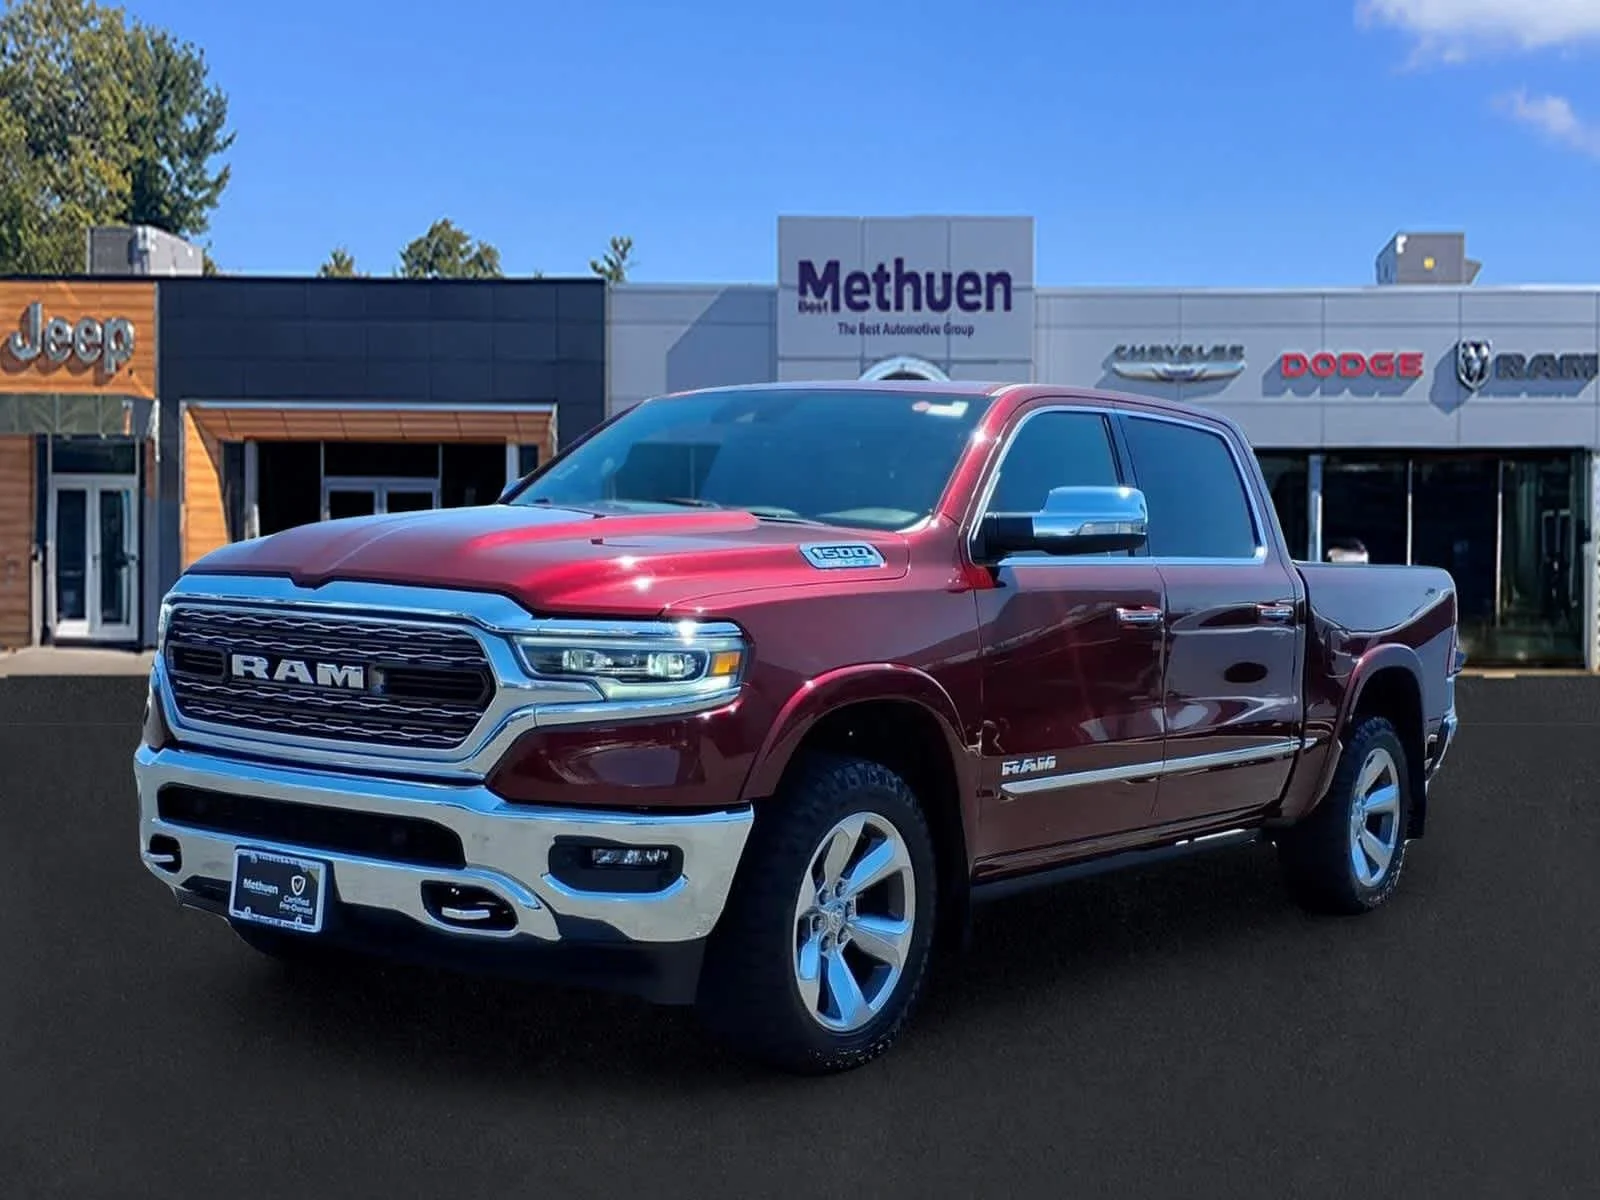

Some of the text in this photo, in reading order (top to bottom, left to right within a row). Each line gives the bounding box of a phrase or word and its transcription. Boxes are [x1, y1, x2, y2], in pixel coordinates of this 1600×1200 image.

[798, 257, 1012, 313] Methuen
[9, 301, 135, 374] Jeep
[838, 321, 975, 338] The Best Automotive Group
[1113, 344, 1245, 361] CHRYSLER
[1281, 352, 1424, 378] DODGE
[1495, 353, 1599, 379] RAM
[811, 546, 869, 560] 1500
[231, 653, 364, 689] RAM
[1002, 755, 1056, 776] RAM
[243, 878, 278, 895] Methuen
